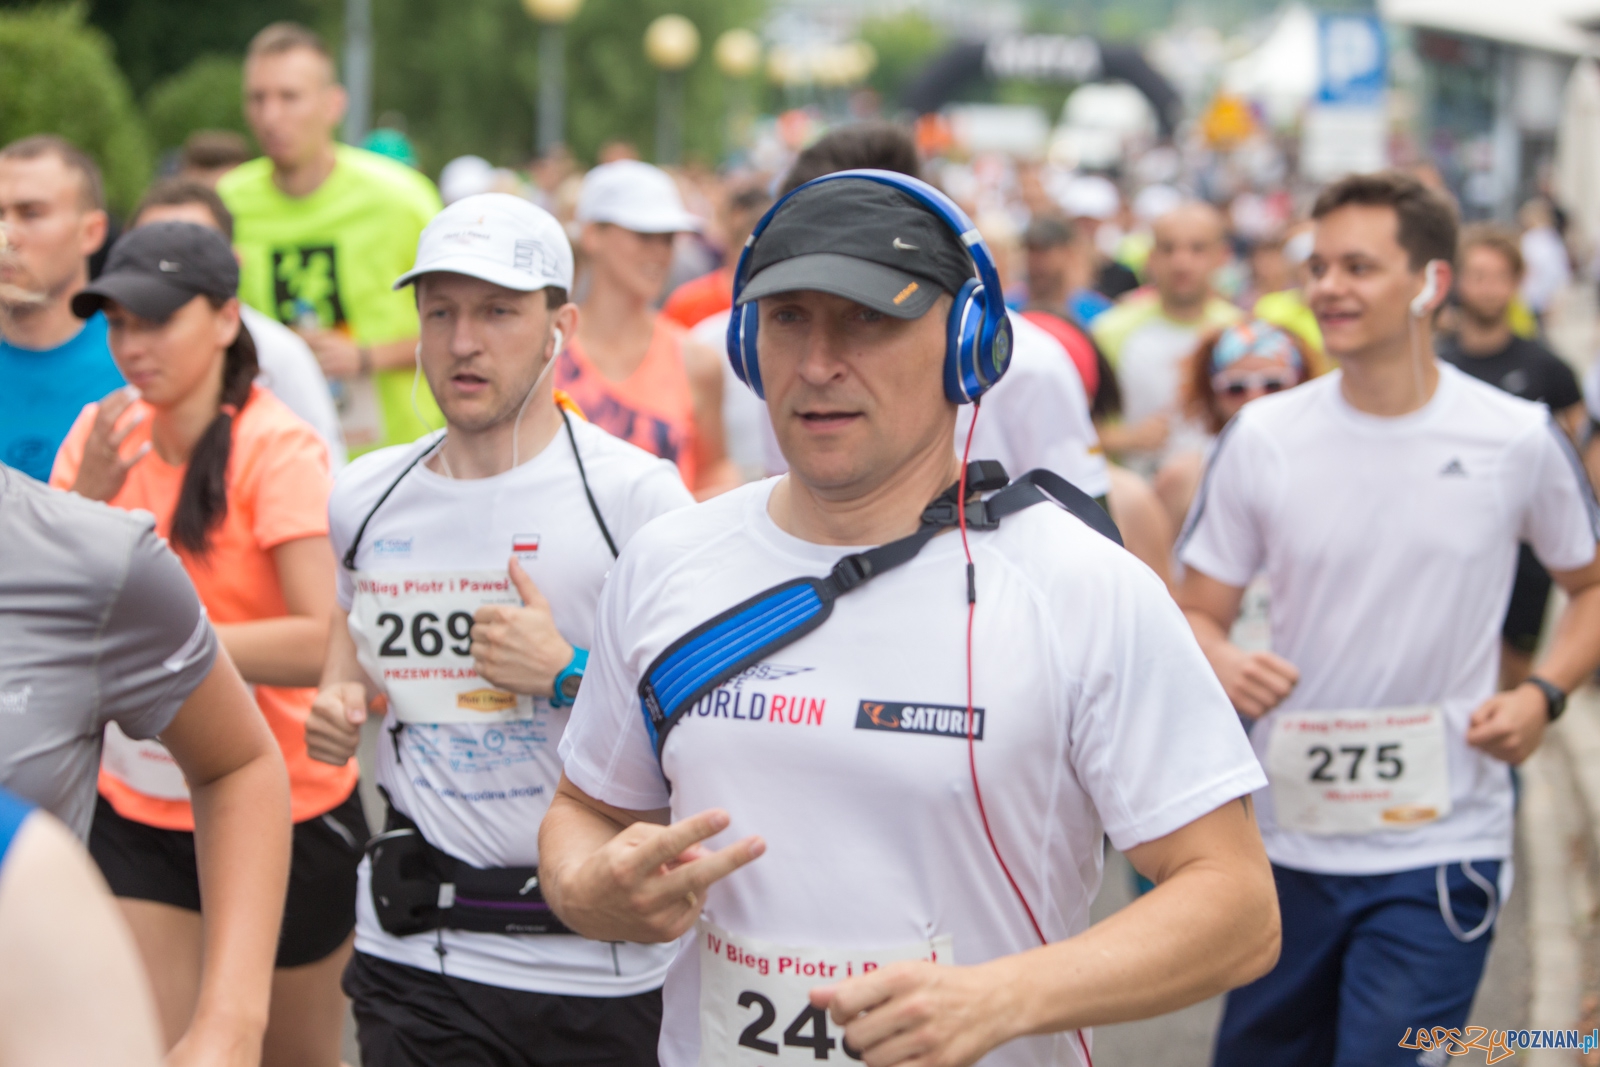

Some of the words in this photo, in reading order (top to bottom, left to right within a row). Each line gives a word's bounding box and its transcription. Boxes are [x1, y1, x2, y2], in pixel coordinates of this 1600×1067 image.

[404, 578, 444, 594] Piotr
[449, 578, 455, 593] i
[376, 609, 474, 658] 269
[686, 689, 767, 722] ORLD
[768, 694, 827, 727] RUN
[900, 707, 980, 736] SATURN
[1307, 743, 1404, 783] 275
[707, 933, 722, 955] IV
[726, 943, 770, 976] Bieg
[777, 956, 837, 978] Piotr
[846, 960, 853, 978] i
[736, 989, 864, 1062] 24
